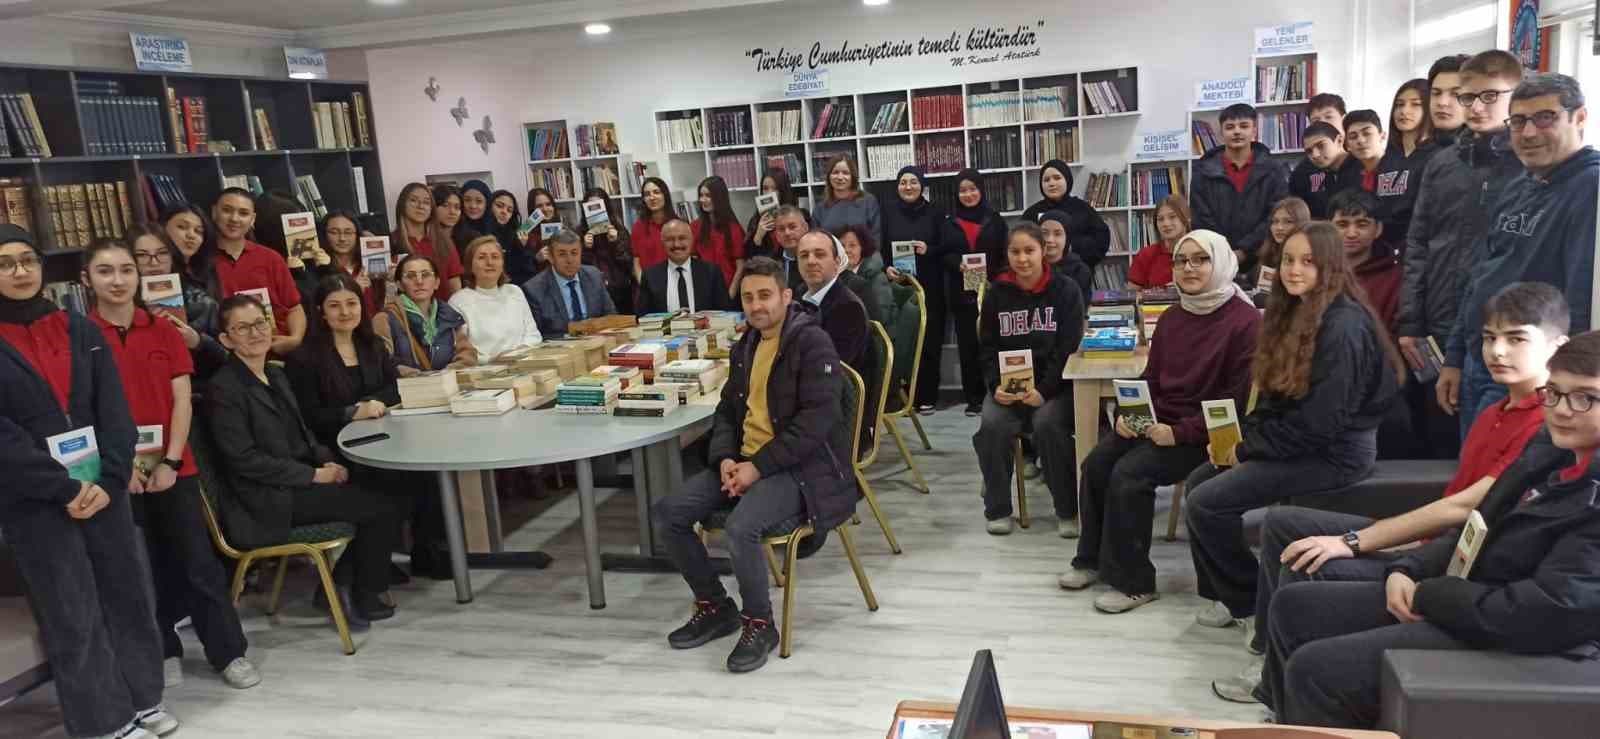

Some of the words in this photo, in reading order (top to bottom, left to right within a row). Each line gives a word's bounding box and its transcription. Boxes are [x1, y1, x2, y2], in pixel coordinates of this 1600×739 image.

[808, 40, 912, 69] Cumhuriyetinin
[917, 32, 961, 56] temeli
[998, 306, 1057, 337] DHAL
